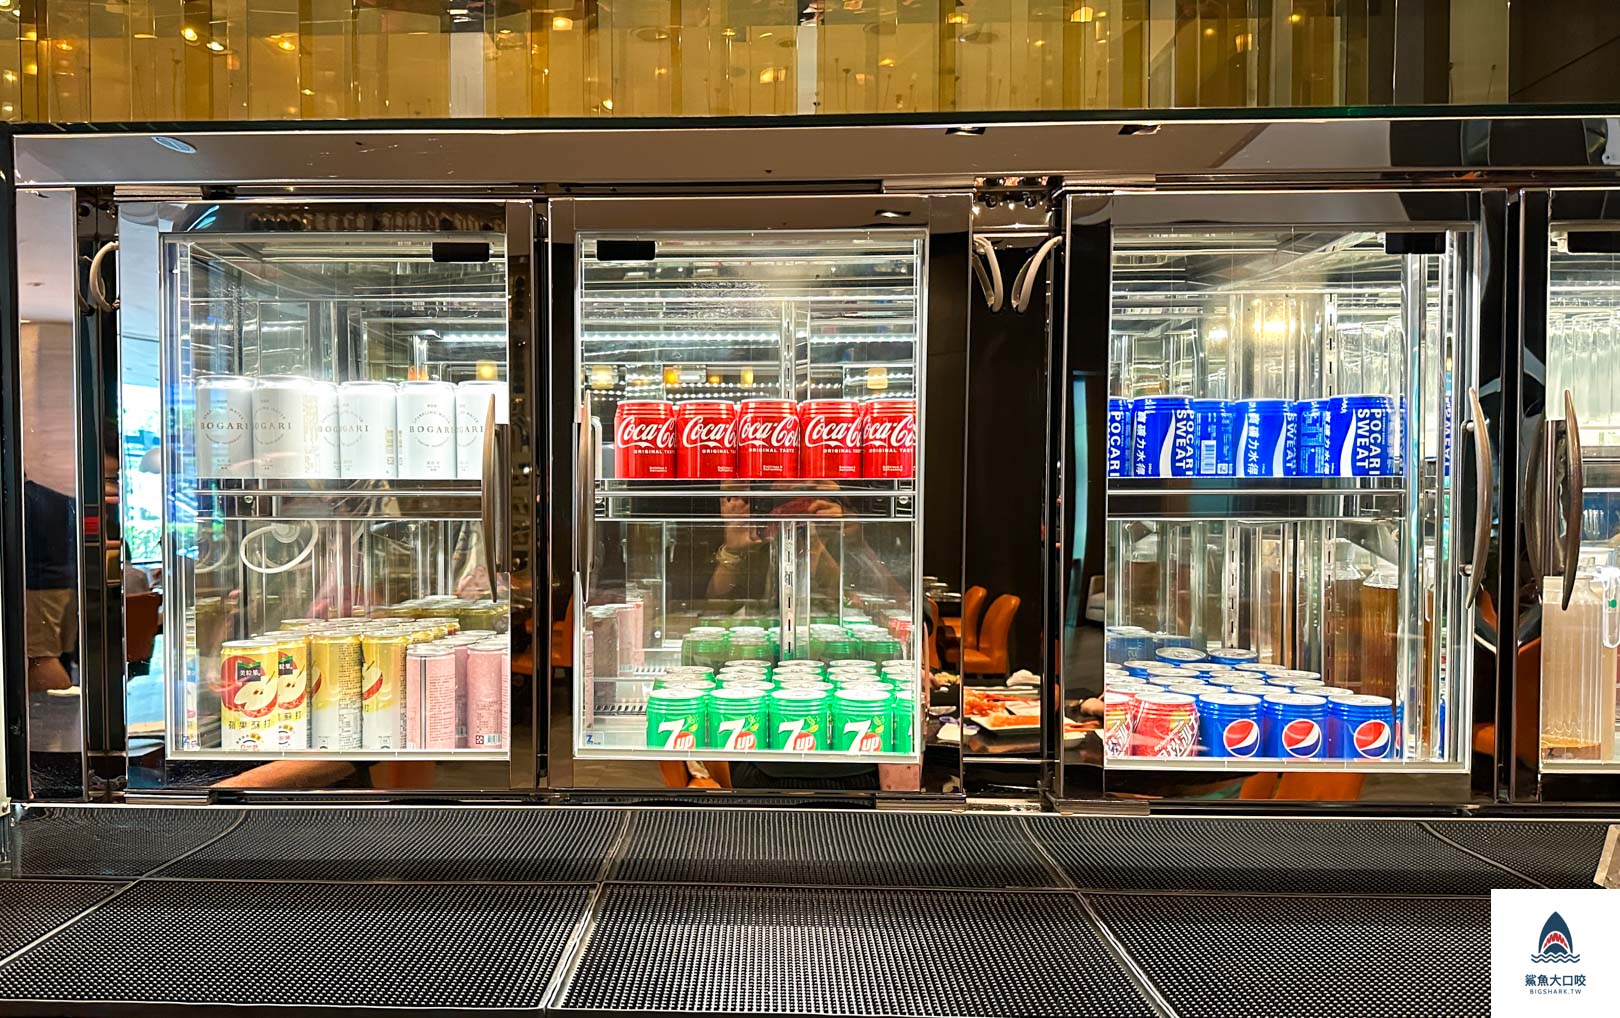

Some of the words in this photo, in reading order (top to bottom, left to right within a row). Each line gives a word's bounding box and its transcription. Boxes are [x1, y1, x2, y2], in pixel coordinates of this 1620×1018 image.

[200, 422, 248, 431] BOGARI
[1110, 411, 1121, 477] POCARI
[1175, 409, 1186, 470] SWEAT
[1185, 409, 1195, 476] POCARI
[1286, 413, 1296, 467] SWEAT
[1356, 408, 1371, 469] SWEAT
[1369, 408, 1382, 475] POCARI
